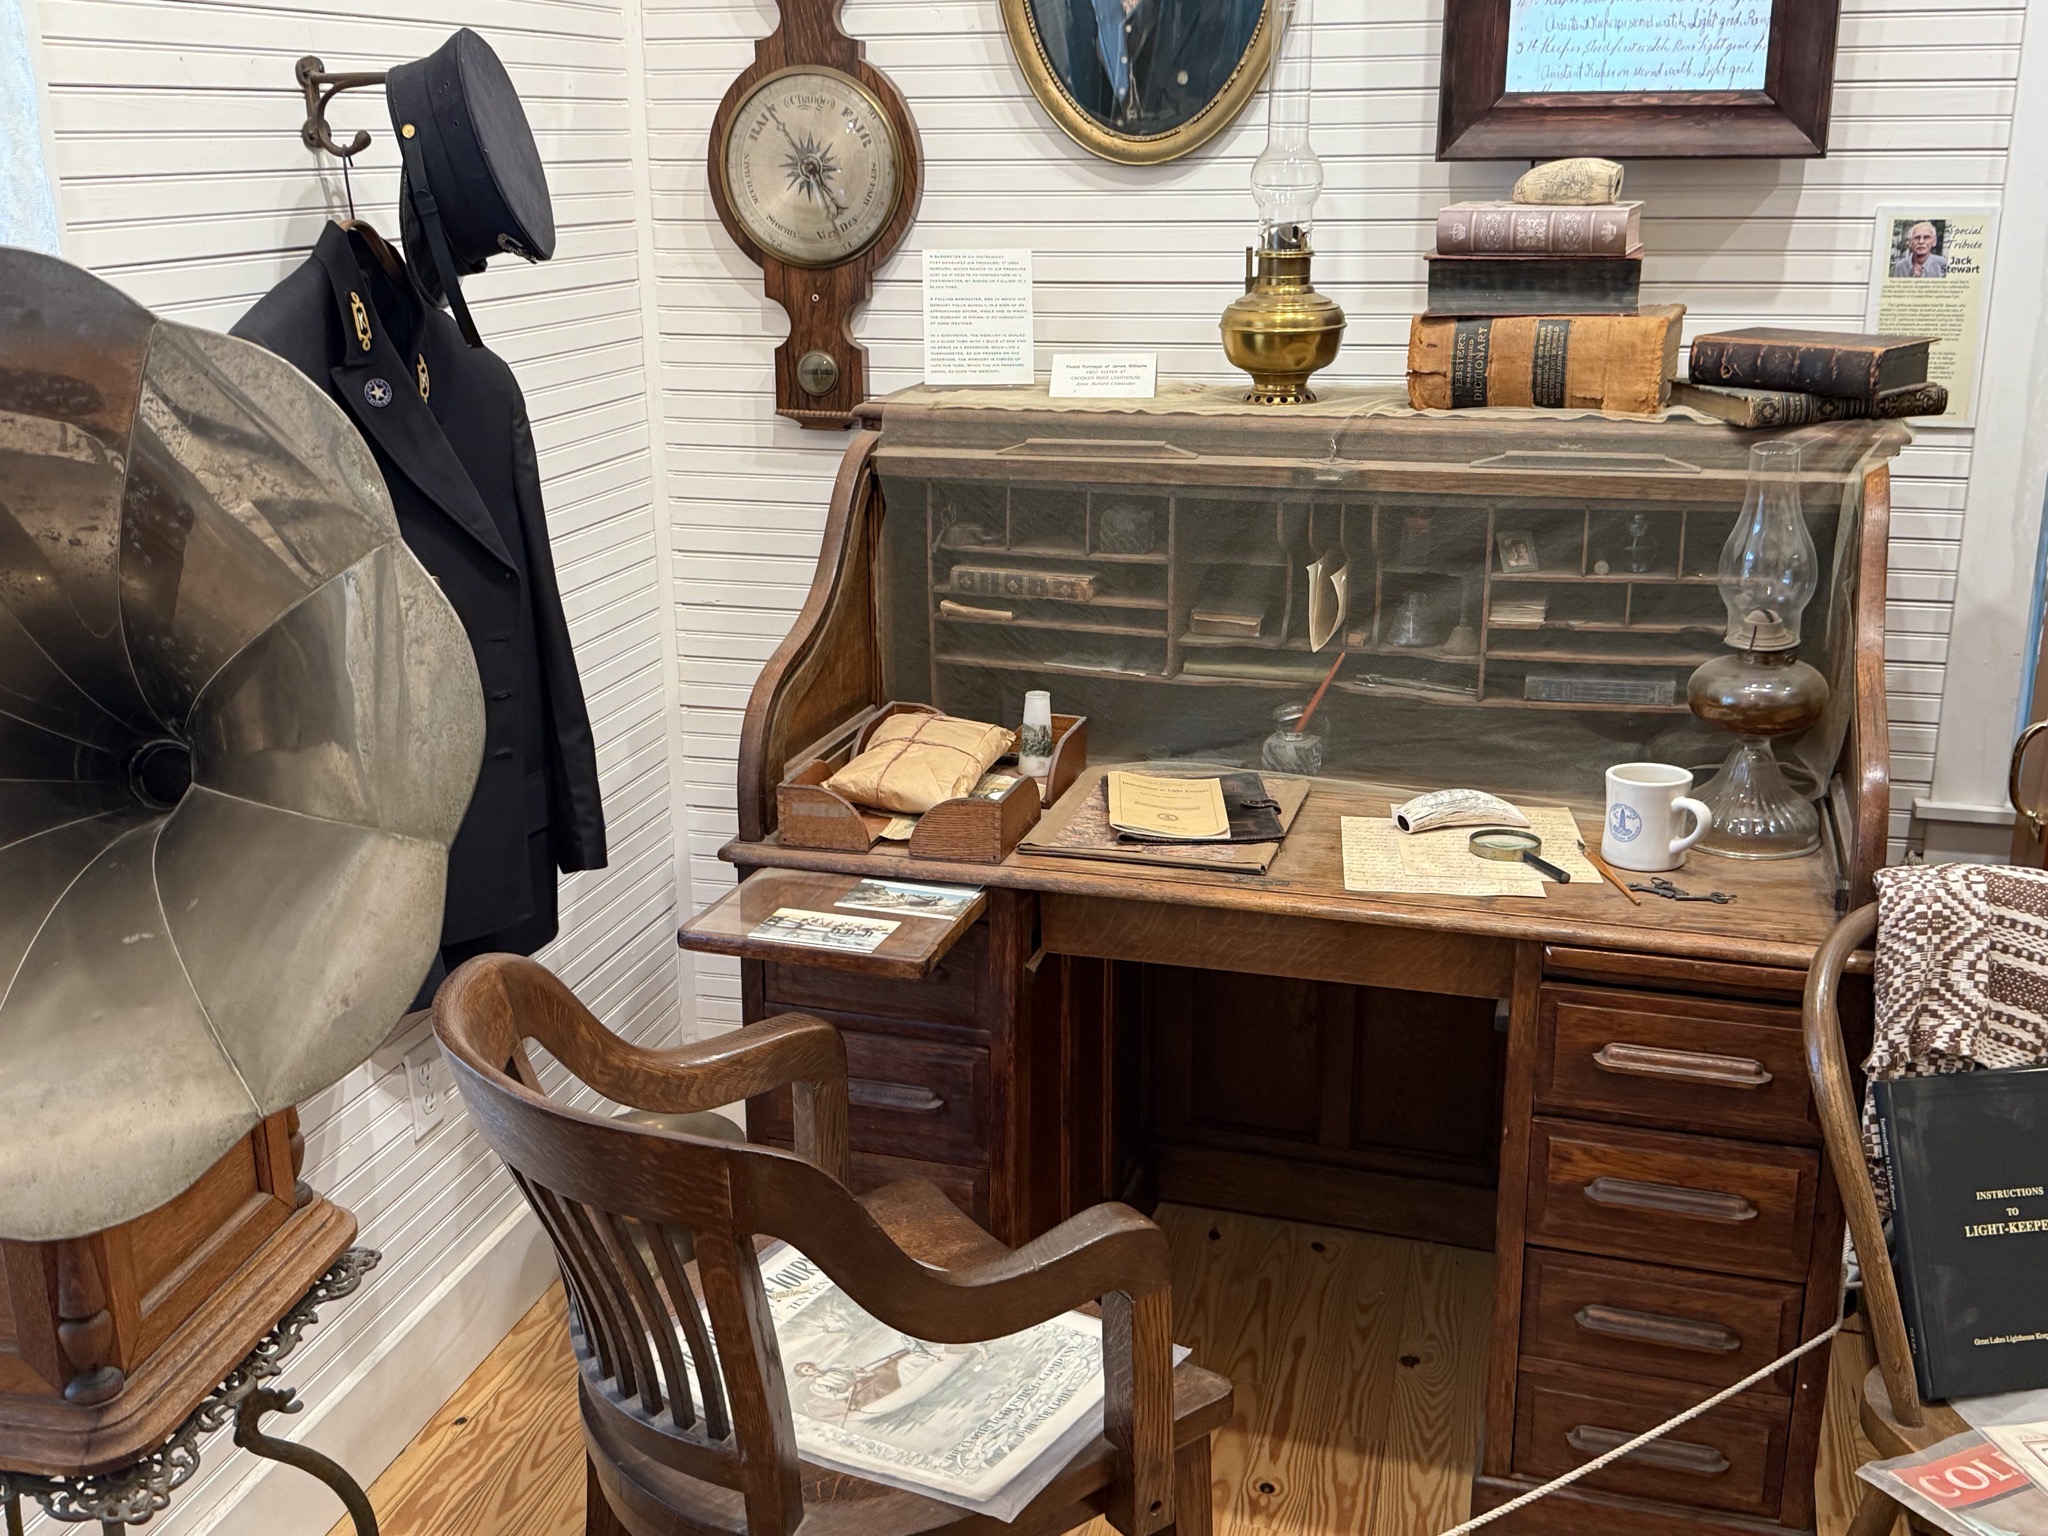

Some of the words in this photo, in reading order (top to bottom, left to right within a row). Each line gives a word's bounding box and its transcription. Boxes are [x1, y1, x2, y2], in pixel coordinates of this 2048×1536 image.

[748, 104, 778, 141] RAIN
[841, 106, 872, 148] FAIR
[1946, 223, 1983, 239] Special
[1944, 238, 1982, 250] Tribute
[1940, 264, 1981, 274] Stewart
[1950, 256, 1972, 265] Jack
[358, 311, 367, 330] K
[1466, 339, 1474, 388] UNABRIDGED
[1474, 327, 1488, 400] DICTIONARY
[1880, 1118, 1889, 1155] Instructions
[1976, 1186, 2044, 1200] INSTRUCTIONS
[2006, 1207, 2019, 1216] TO
[1964, 1219, 2048, 1237] LIGHT-KEEPE
[787, 1296, 809, 1310] TEN
[2006, 1334, 2035, 1343] Lighthouse
[1016, 1387, 1078, 1438] PHILADELPHIA
